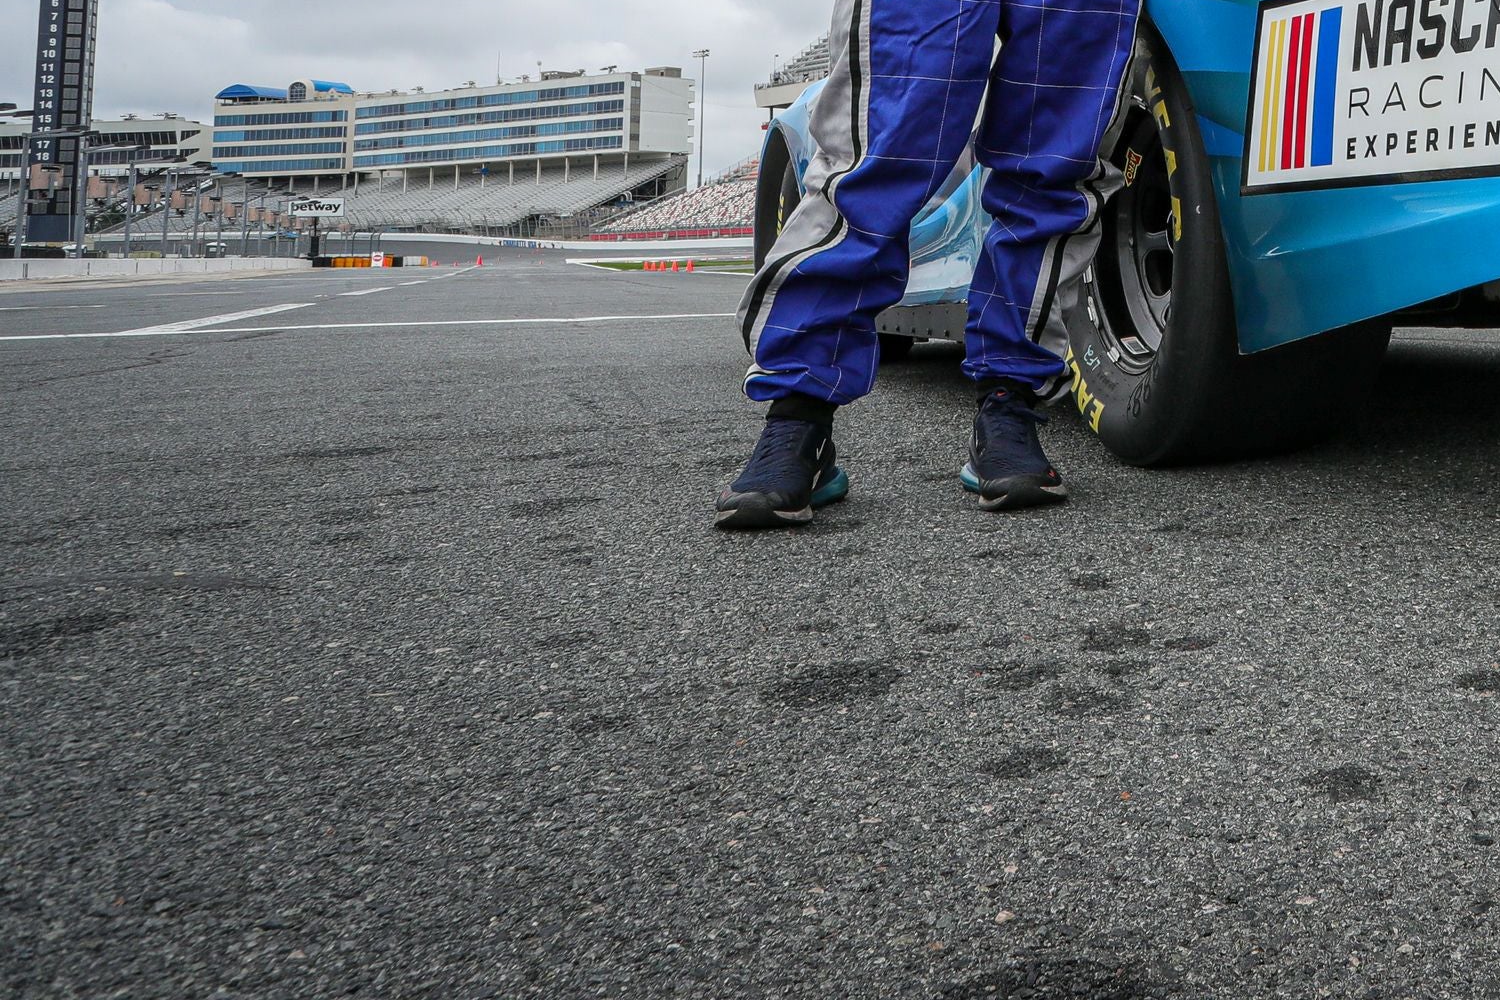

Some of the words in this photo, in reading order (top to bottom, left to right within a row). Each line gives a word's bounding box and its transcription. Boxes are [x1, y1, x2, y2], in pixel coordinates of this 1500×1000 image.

[51, 12, 58, 20] 7
[50, 24, 57, 33] 8
[49, 38, 57, 46] 9
[42, 49, 56, 58] 10
[41, 63, 54, 72] 11
[40, 75, 55, 84] 12
[39, 89, 53, 97] 13
[39, 101, 53, 109] 14
[38, 114, 52, 123] 15
[36, 140, 50, 149] 17
[35, 152, 50, 161] 18
[291, 201, 342, 213] betway
